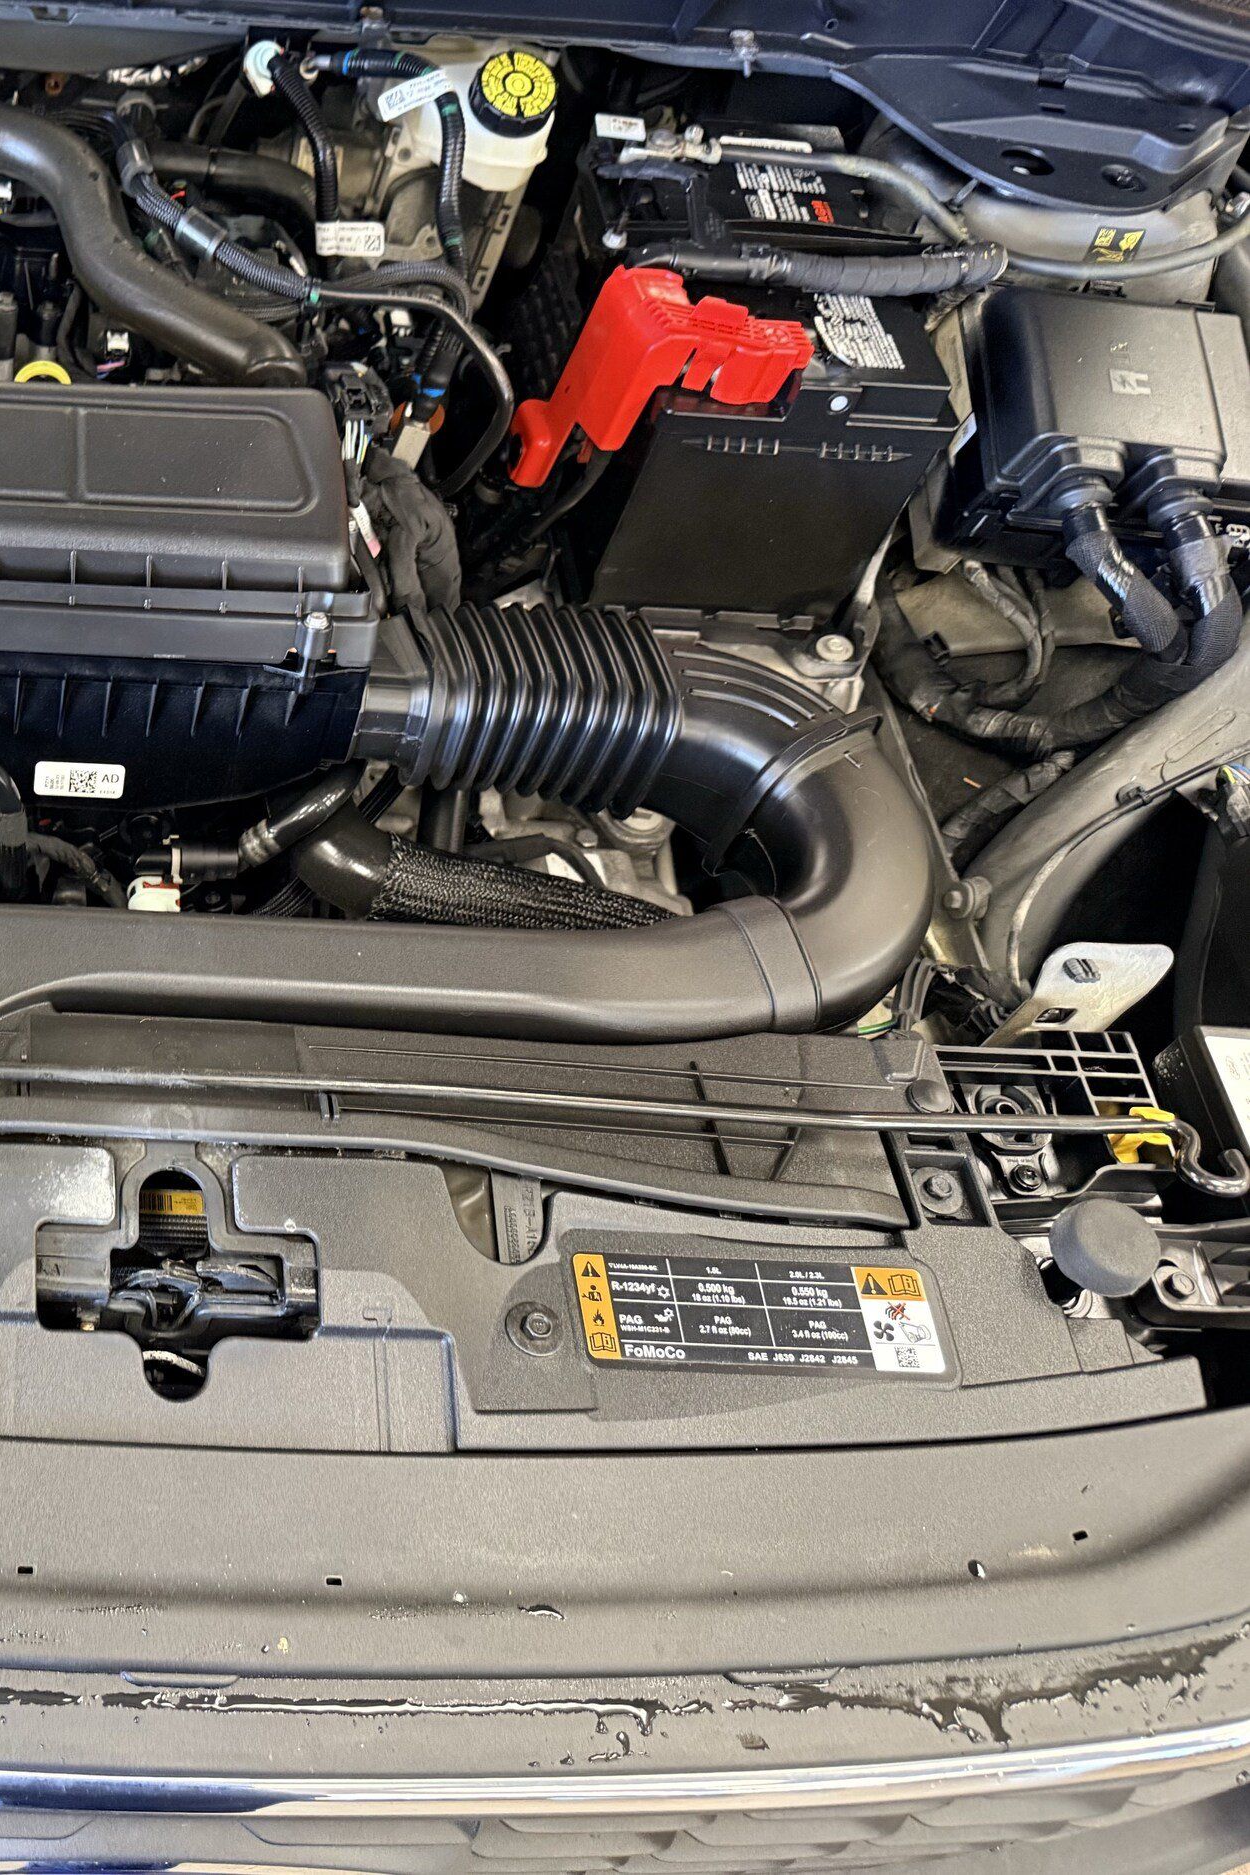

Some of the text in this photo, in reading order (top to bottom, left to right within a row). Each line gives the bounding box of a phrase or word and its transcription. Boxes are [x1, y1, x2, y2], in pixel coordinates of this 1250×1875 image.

[101, 773, 120, 784] AD
[611, 1280, 656, 1295] R-1234yf
[698, 1282, 735, 1296] 0.500 kg
[791, 1286, 828, 1299] 0.550 kg
[692, 1292, 701, 1302] 18
[712, 1294, 731, 1304] (1.10
[731, 1296, 746, 1305] lbs)
[809, 1298, 828, 1308] (1.21
[828, 1298, 842, 1308] lbs)
[618, 1314, 644, 1325] PAG
[714, 1316, 732, 1326] PAG
[808, 1320, 827, 1330] PAG
[698, 1325, 710, 1334] 2.7
[710, 1326, 718, 1334] fl
[792, 1330, 849, 1342] 3.4 fl oz (100cc)
[624, 1344, 686, 1360] FoMoCo
[748, 1352, 859, 1364] SAE J639 J2842 J2845
